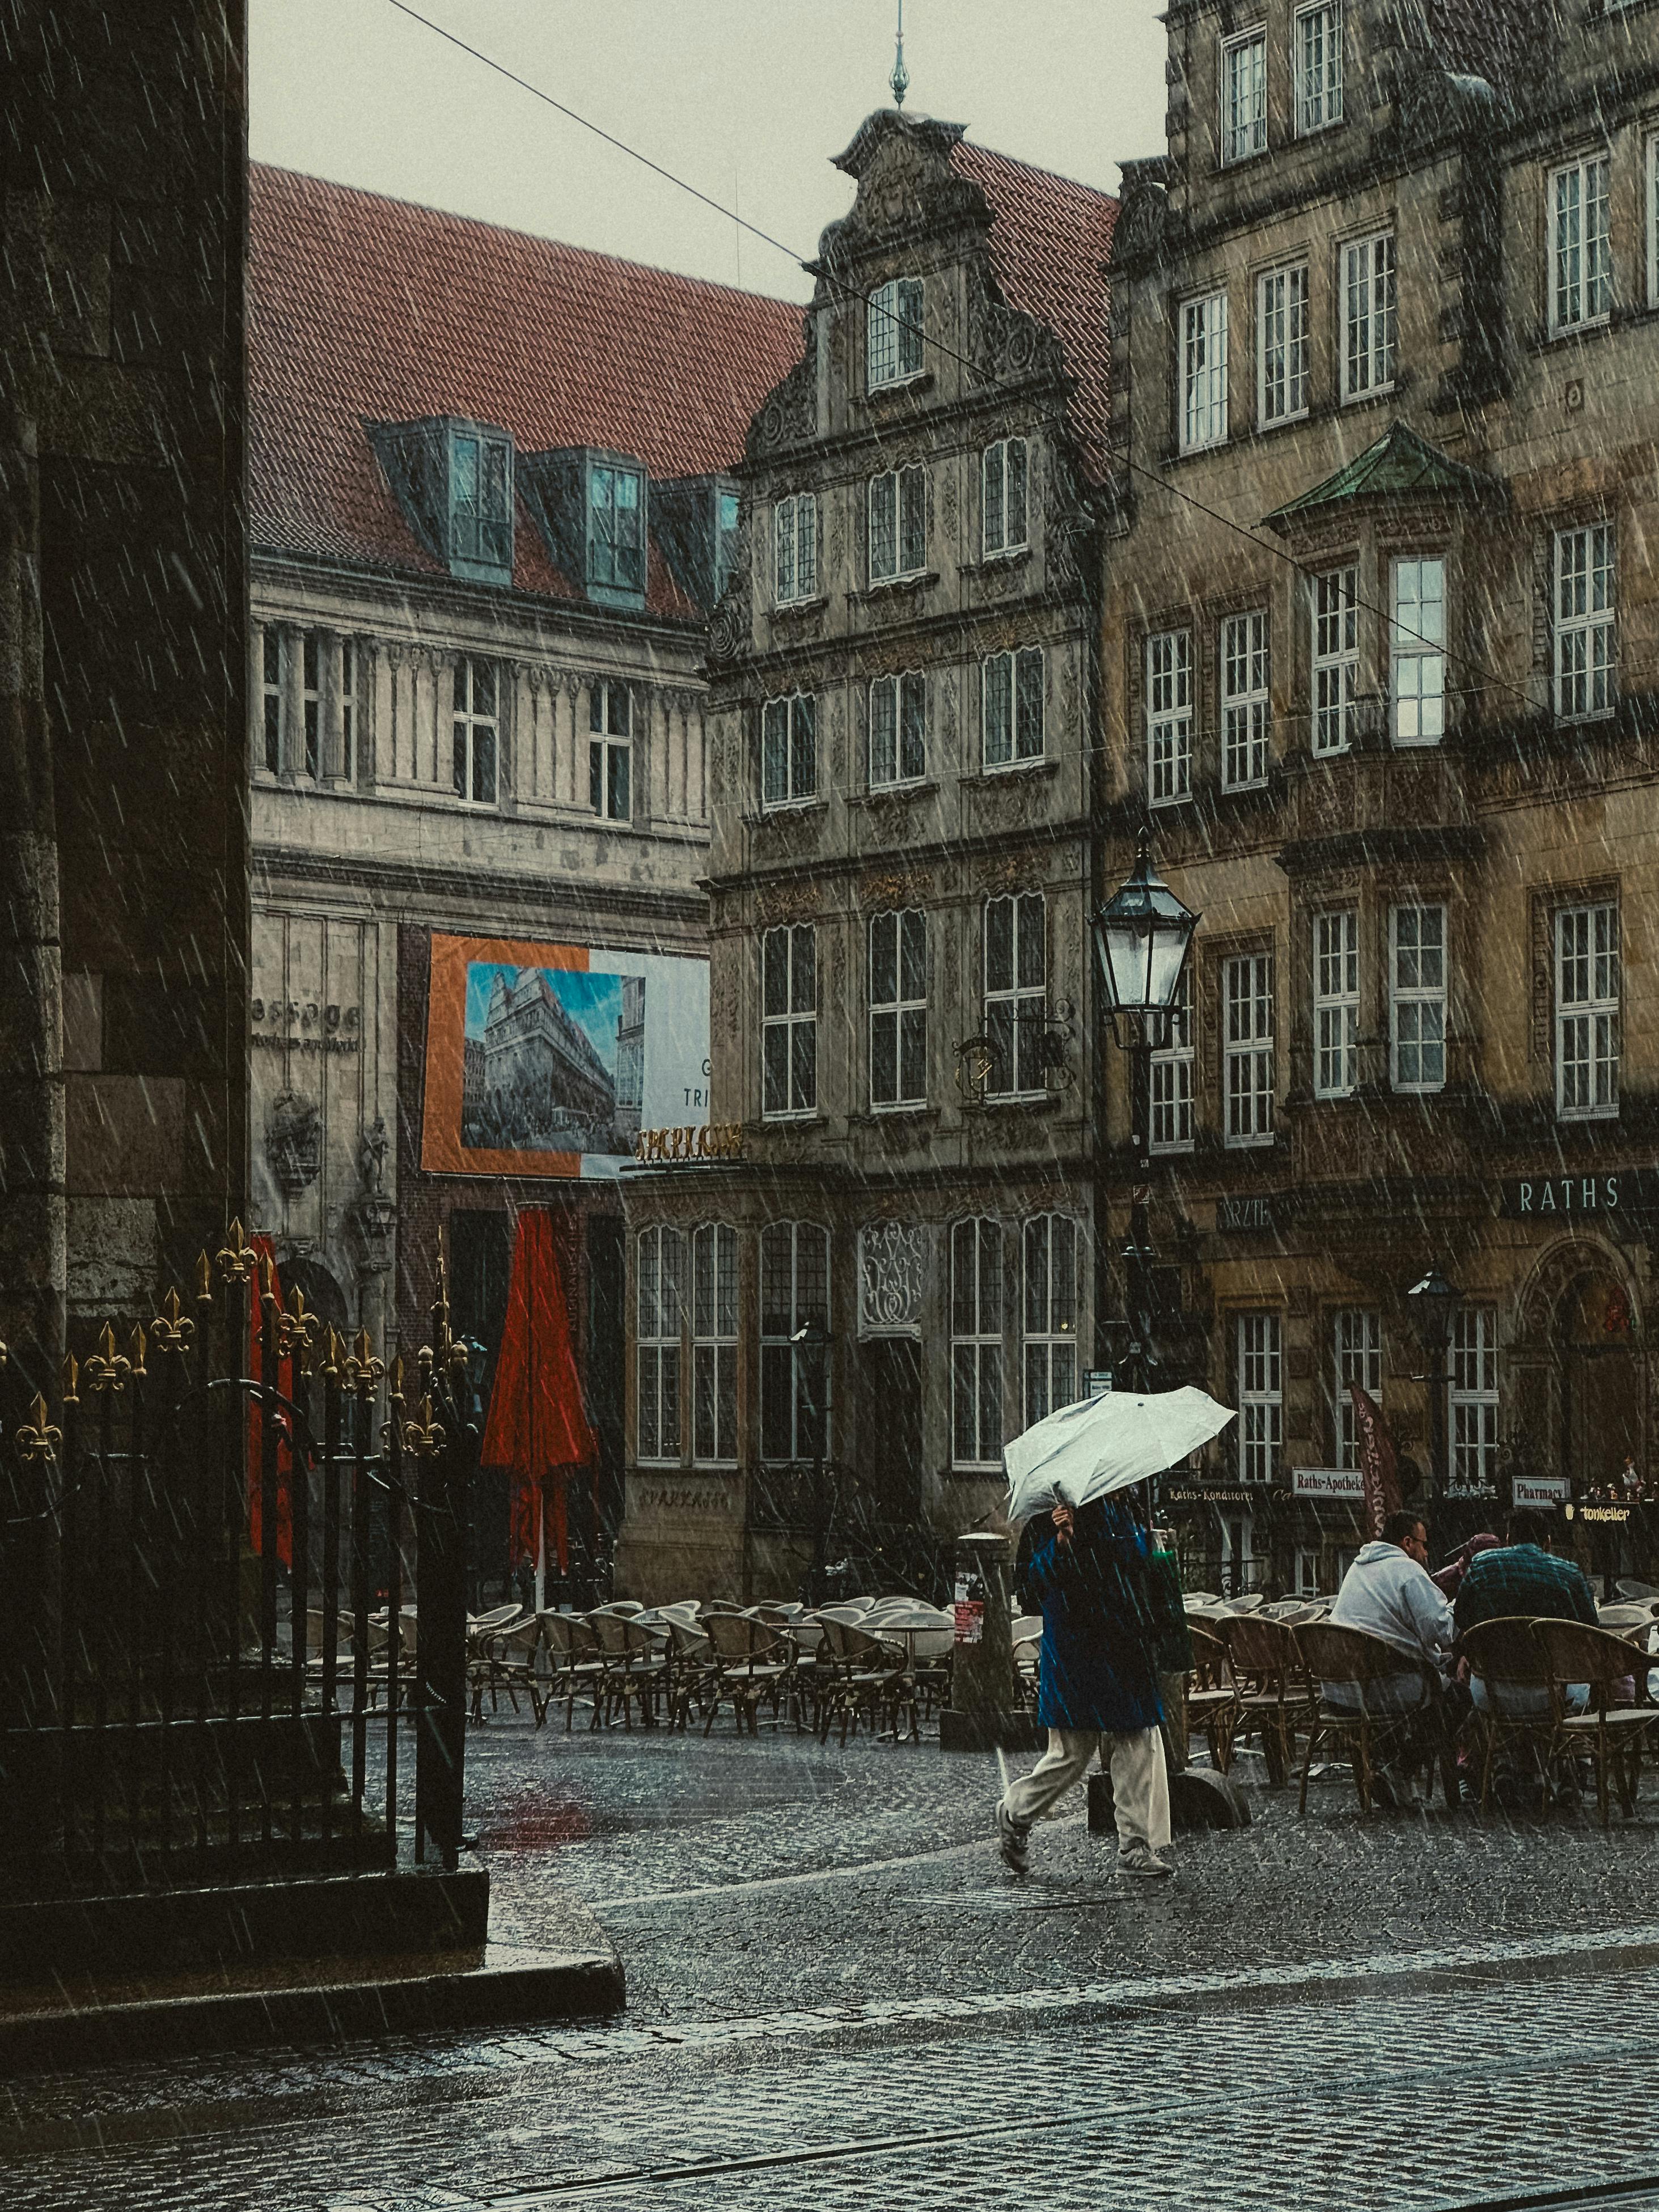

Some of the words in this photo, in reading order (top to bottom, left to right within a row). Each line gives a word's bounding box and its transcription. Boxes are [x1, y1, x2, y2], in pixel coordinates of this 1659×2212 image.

[252, 999, 360, 1033] assage
[1520, 1177, 1618, 1211] RATHS
[1297, 1473, 1365, 1493] Raths-Apotheke
[1517, 1483, 1563, 1500] Pharmacy
[1580, 1506, 1630, 1522] tonkeller
